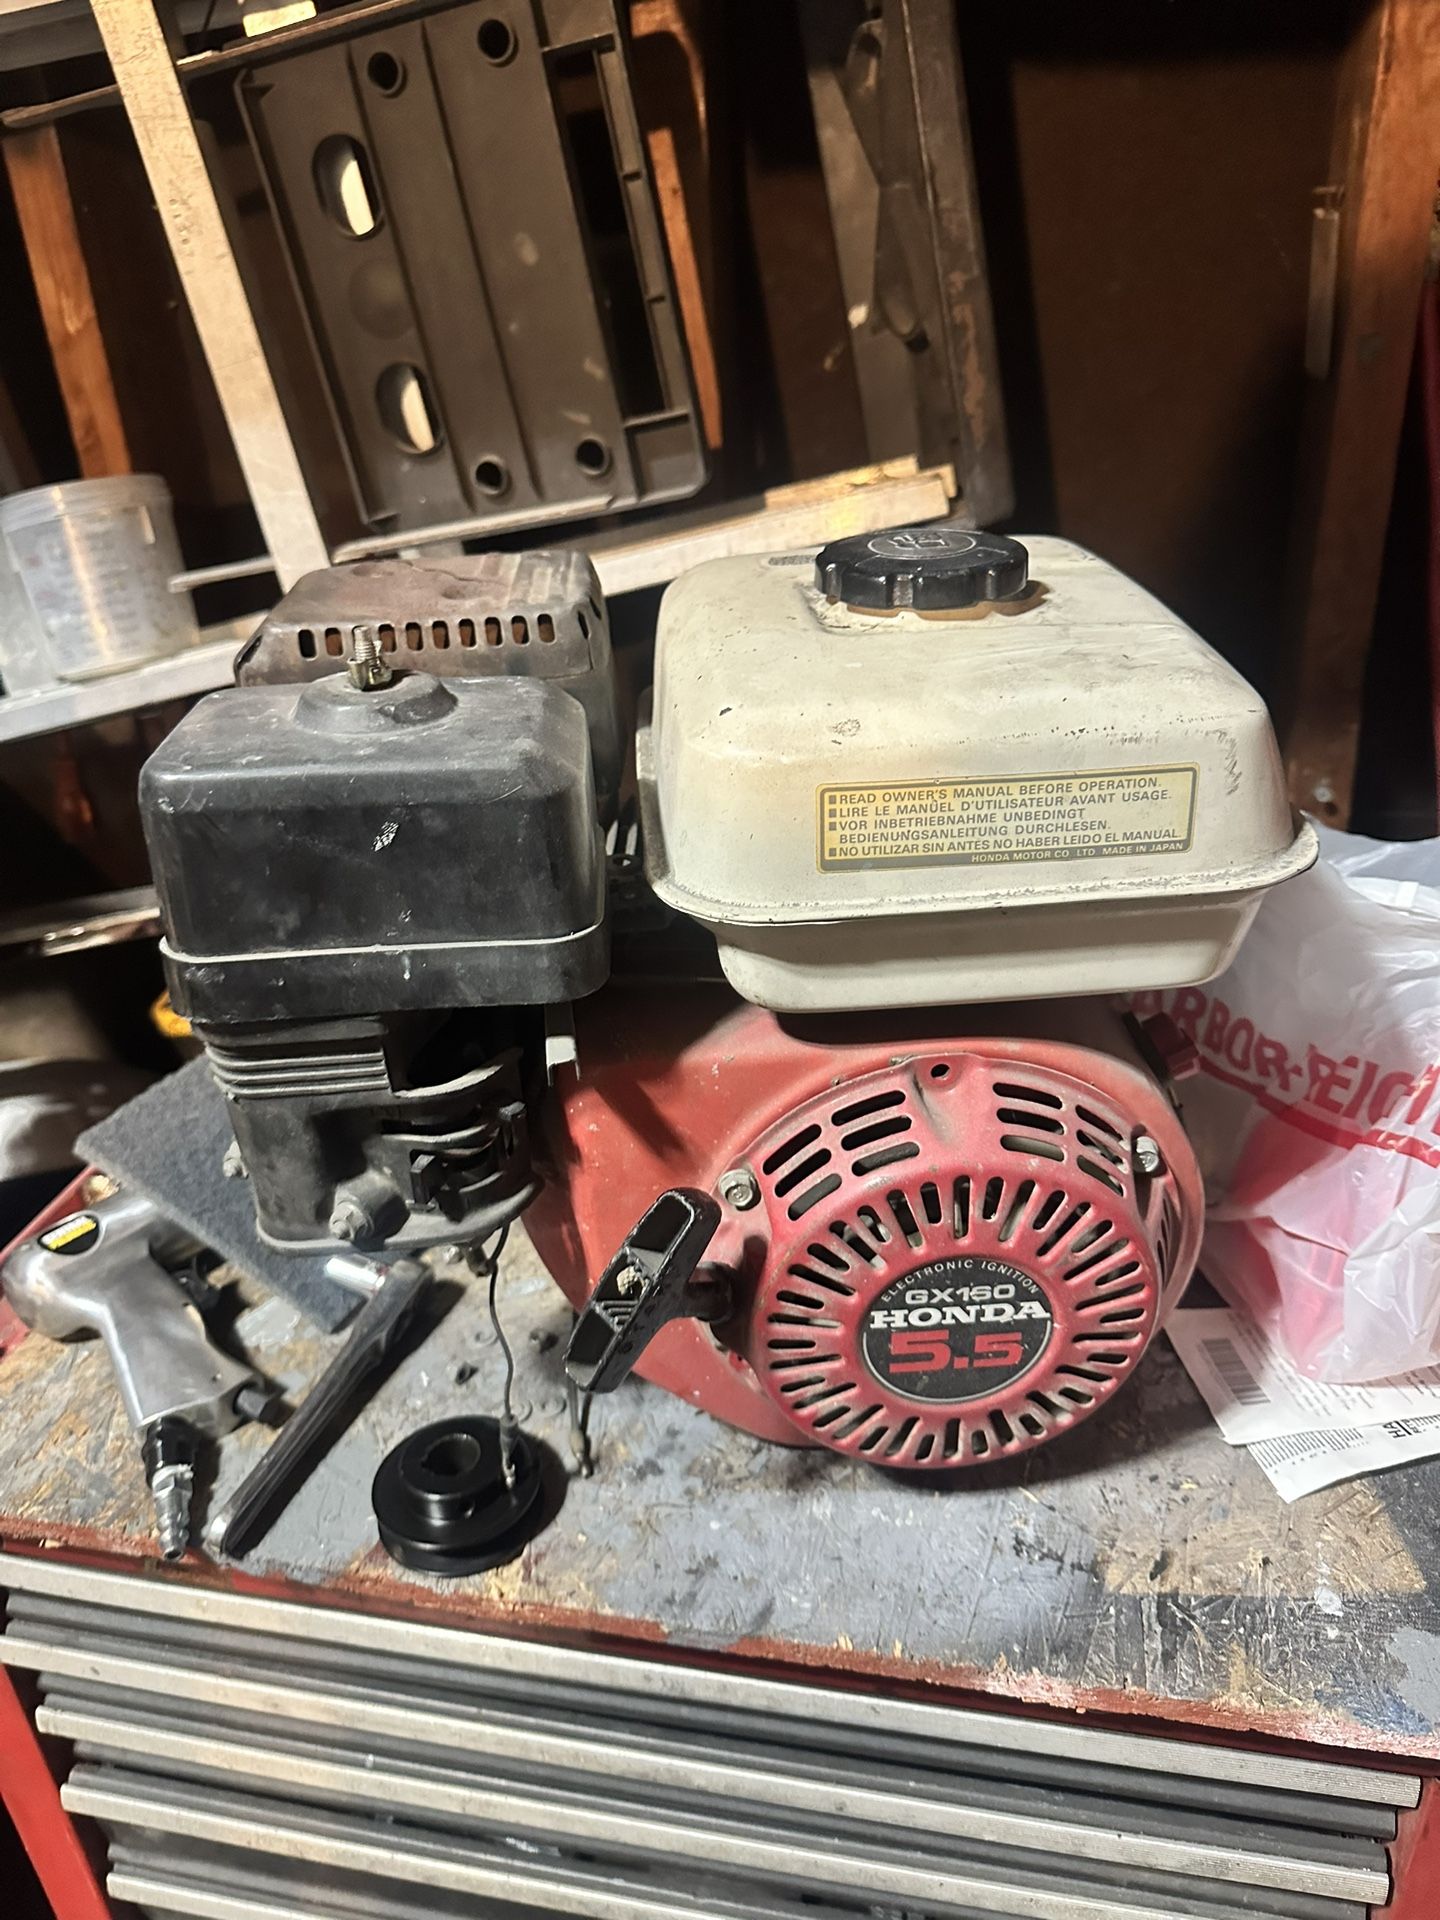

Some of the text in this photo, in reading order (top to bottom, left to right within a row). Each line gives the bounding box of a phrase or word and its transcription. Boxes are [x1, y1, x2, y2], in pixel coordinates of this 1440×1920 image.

[840, 777, 1161, 805] READ OWNER'S MANUAL BEFORE OPERATION.
[840, 807, 868, 818] LIRE
[875, 805, 890, 816] LE
[961, 797, 1064, 811] D'UTILISATEUR
[1070, 793, 1115, 805] AVANT
[1122, 790, 1171, 802] USAGE.
[839, 808, 1086, 831] VOR INBETRIEBNAHME UNBEDINGT
[839, 847, 858, 857] NO
[862, 844, 919, 856] UTILIZAR
[922, 843, 944, 853] SIN
[947, 840, 990, 851] ANTES
[993, 839, 1012, 849] NO
[1016, 836, 1060, 848] HABER
[1064, 833, 1102, 845] LEIDO
[1105, 833, 1119, 843] EL
[840, 825, 1008, 844] BEDIENUNGSANLEITUNG
[971, 852, 1010, 863] HONDA
[1013, 850, 1051, 860] MOTOR
[1102, 844, 1133, 855] MADE
[1136, 843, 1147, 852] IN
[1150, 842, 1184, 852] JAPAN
[881, 1259, 1039, 1303] ELECTRONIC IGNITION
[870, 1301, 1050, 1328] HONDA
[889, 1329, 1024, 1374] 5.5
